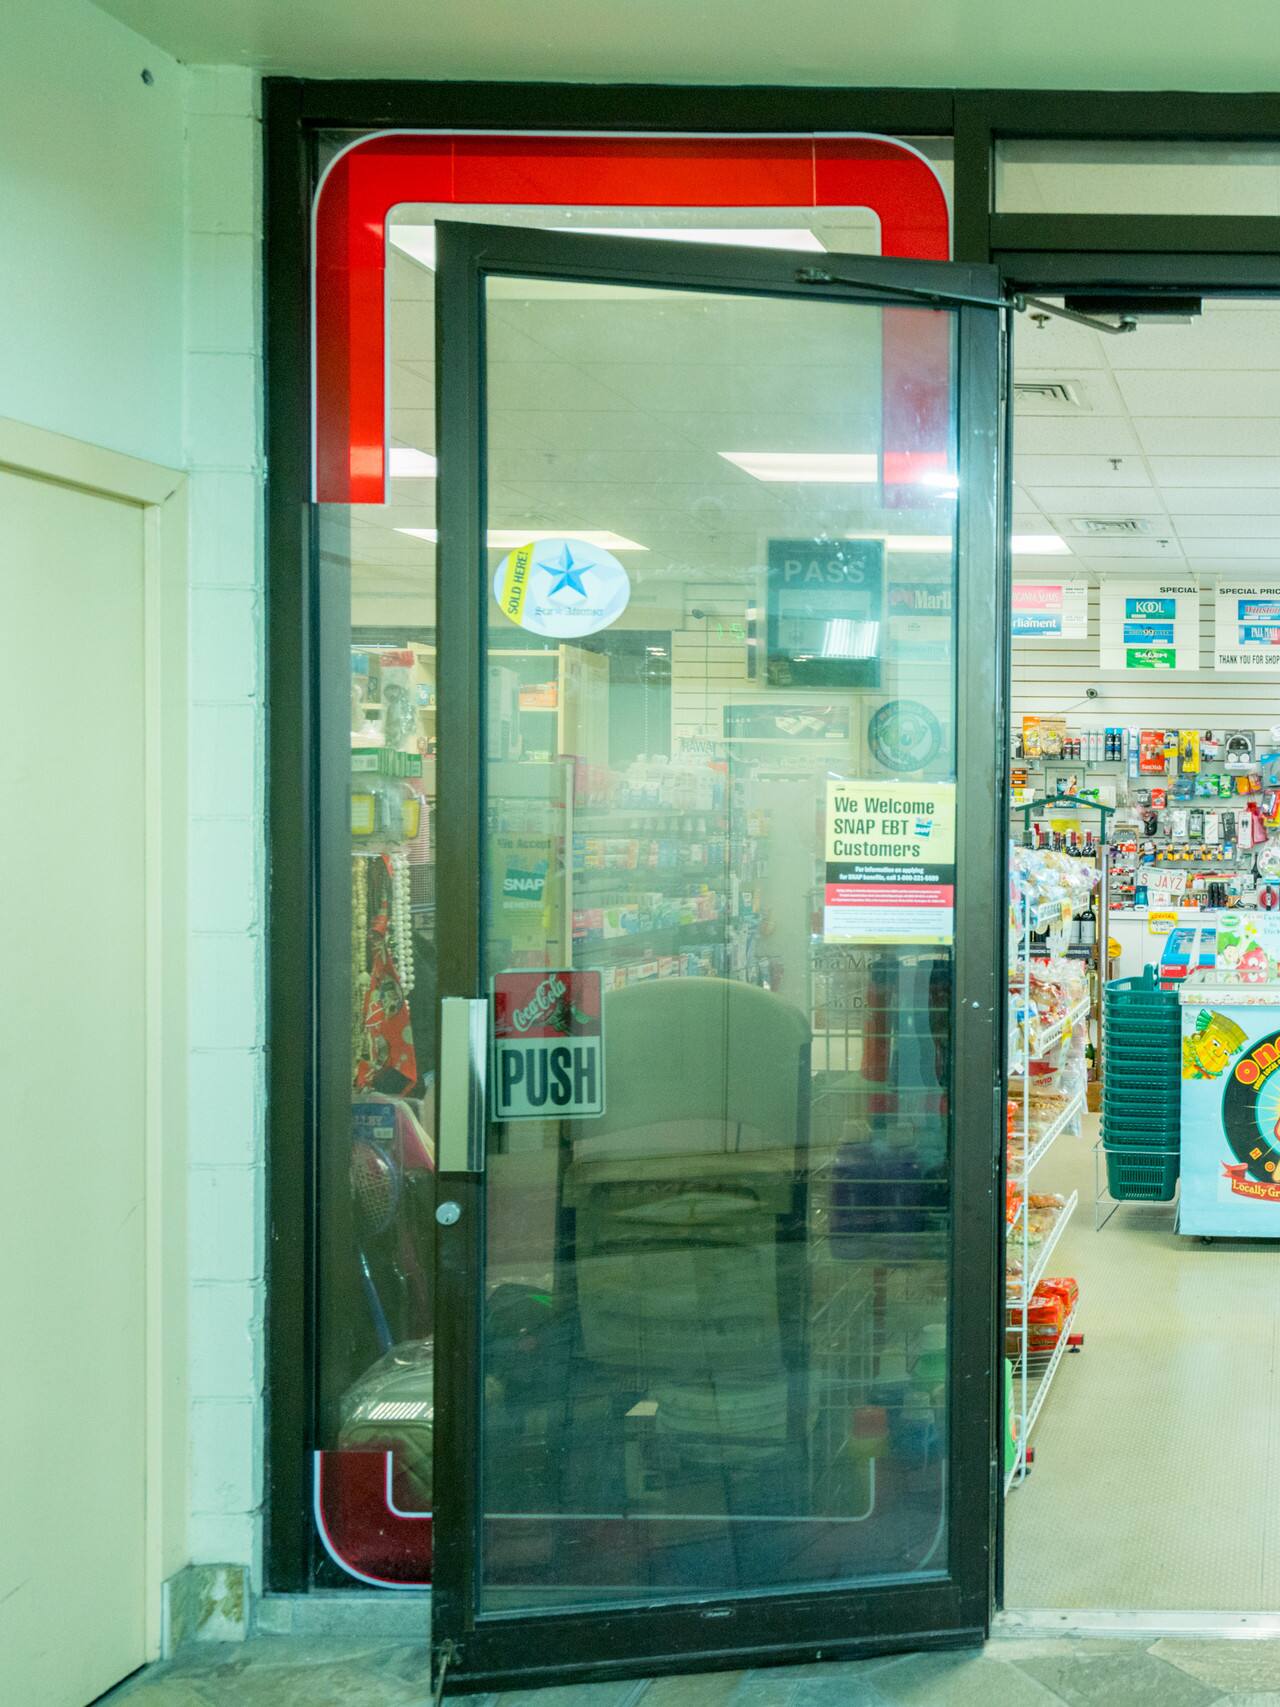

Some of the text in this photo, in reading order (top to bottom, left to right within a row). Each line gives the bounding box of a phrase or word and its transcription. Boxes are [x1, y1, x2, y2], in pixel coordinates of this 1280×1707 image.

[784, 559, 866, 584] PASS
[507, 551, 529, 614] SOLD HERE!
[915, 591, 951, 609] Marl
[1136, 601, 1164, 613] KOOL
[1219, 655, 1238, 664] THANK
[1240, 655, 1251, 664] YOU
[1252, 655, 1264, 664] FOR
[835, 797, 934, 815] We Welcome
[834, 818, 909, 835] SNAP EBT
[834, 840, 920, 857] Customers
[504, 879, 544, 891] SNAP
[512, 973, 566, 1032] Coca-Cola
[501, 1047, 596, 1107] PUSH
[1232, 1180, 1267, 1197] Locally
